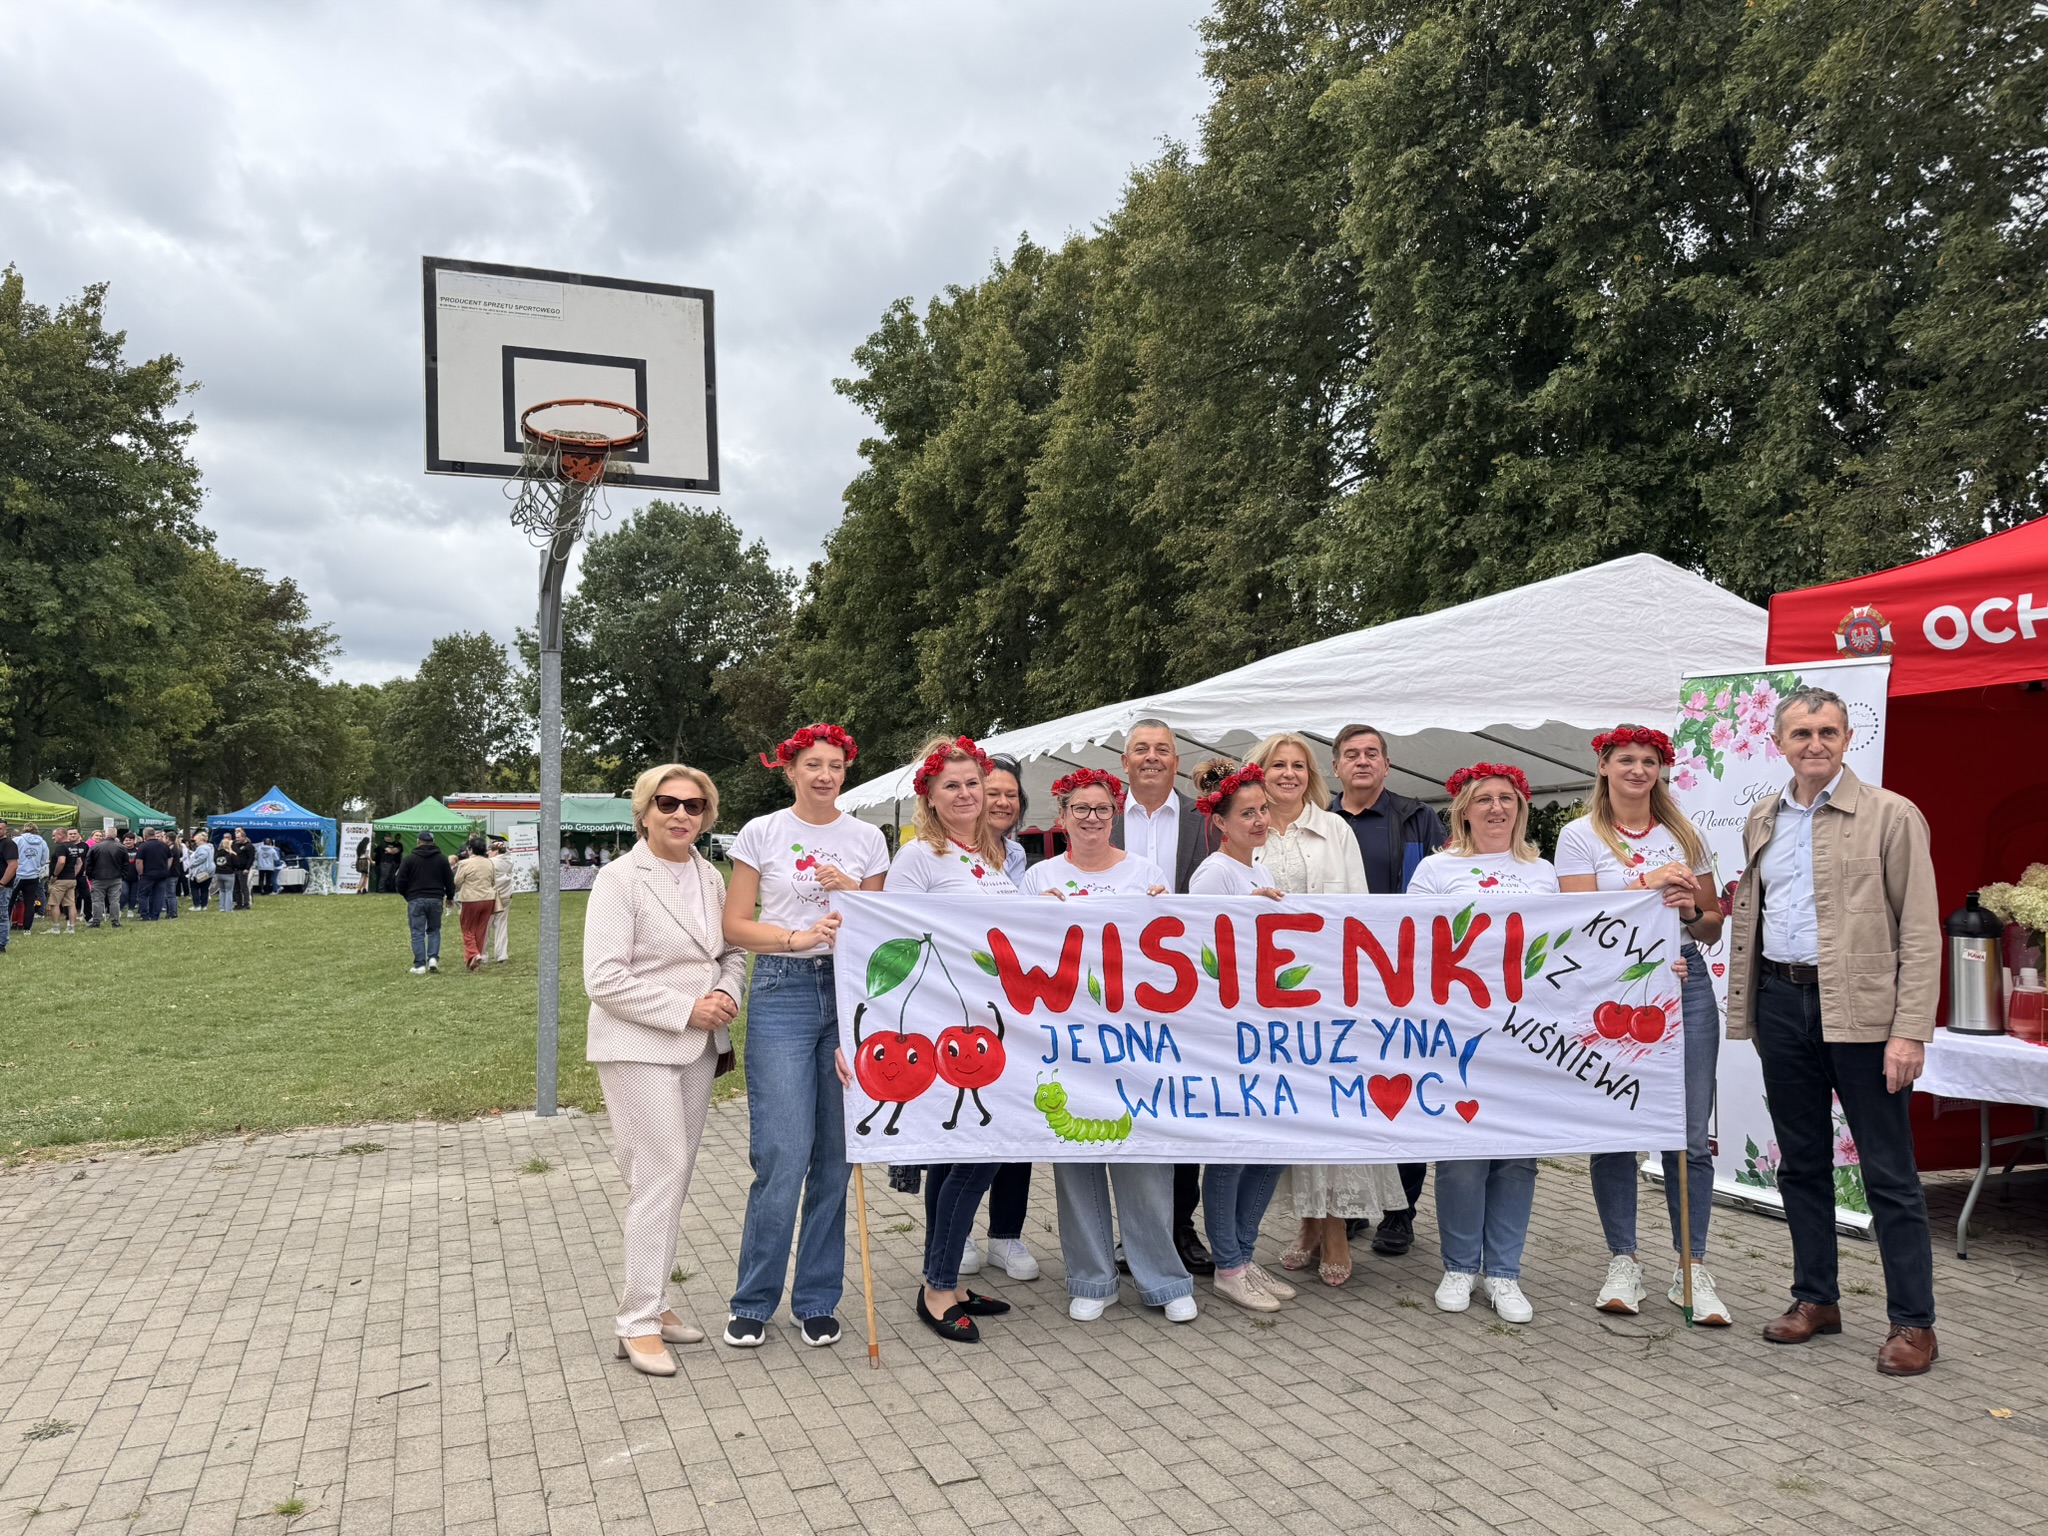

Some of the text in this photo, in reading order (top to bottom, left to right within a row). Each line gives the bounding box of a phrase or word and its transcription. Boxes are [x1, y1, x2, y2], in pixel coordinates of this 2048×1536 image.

[440, 296, 482, 306] PRODUCENT
[514, 304, 561, 315] SPORTOWEGO
[575, 823, 615, 832] Gospodyń
[1581, 911, 1666, 963] KGW
[1967, 951, 1985, 961] KAWA
[986, 911, 1525, 1015] WISIENKI
[1546, 955, 1582, 990] Z
[1039, 1020, 1181, 1064] JEDNA
[1502, 1005, 1640, 1110] WIŚNIEWA
[1115, 1073, 1299, 1119] WIELKA
